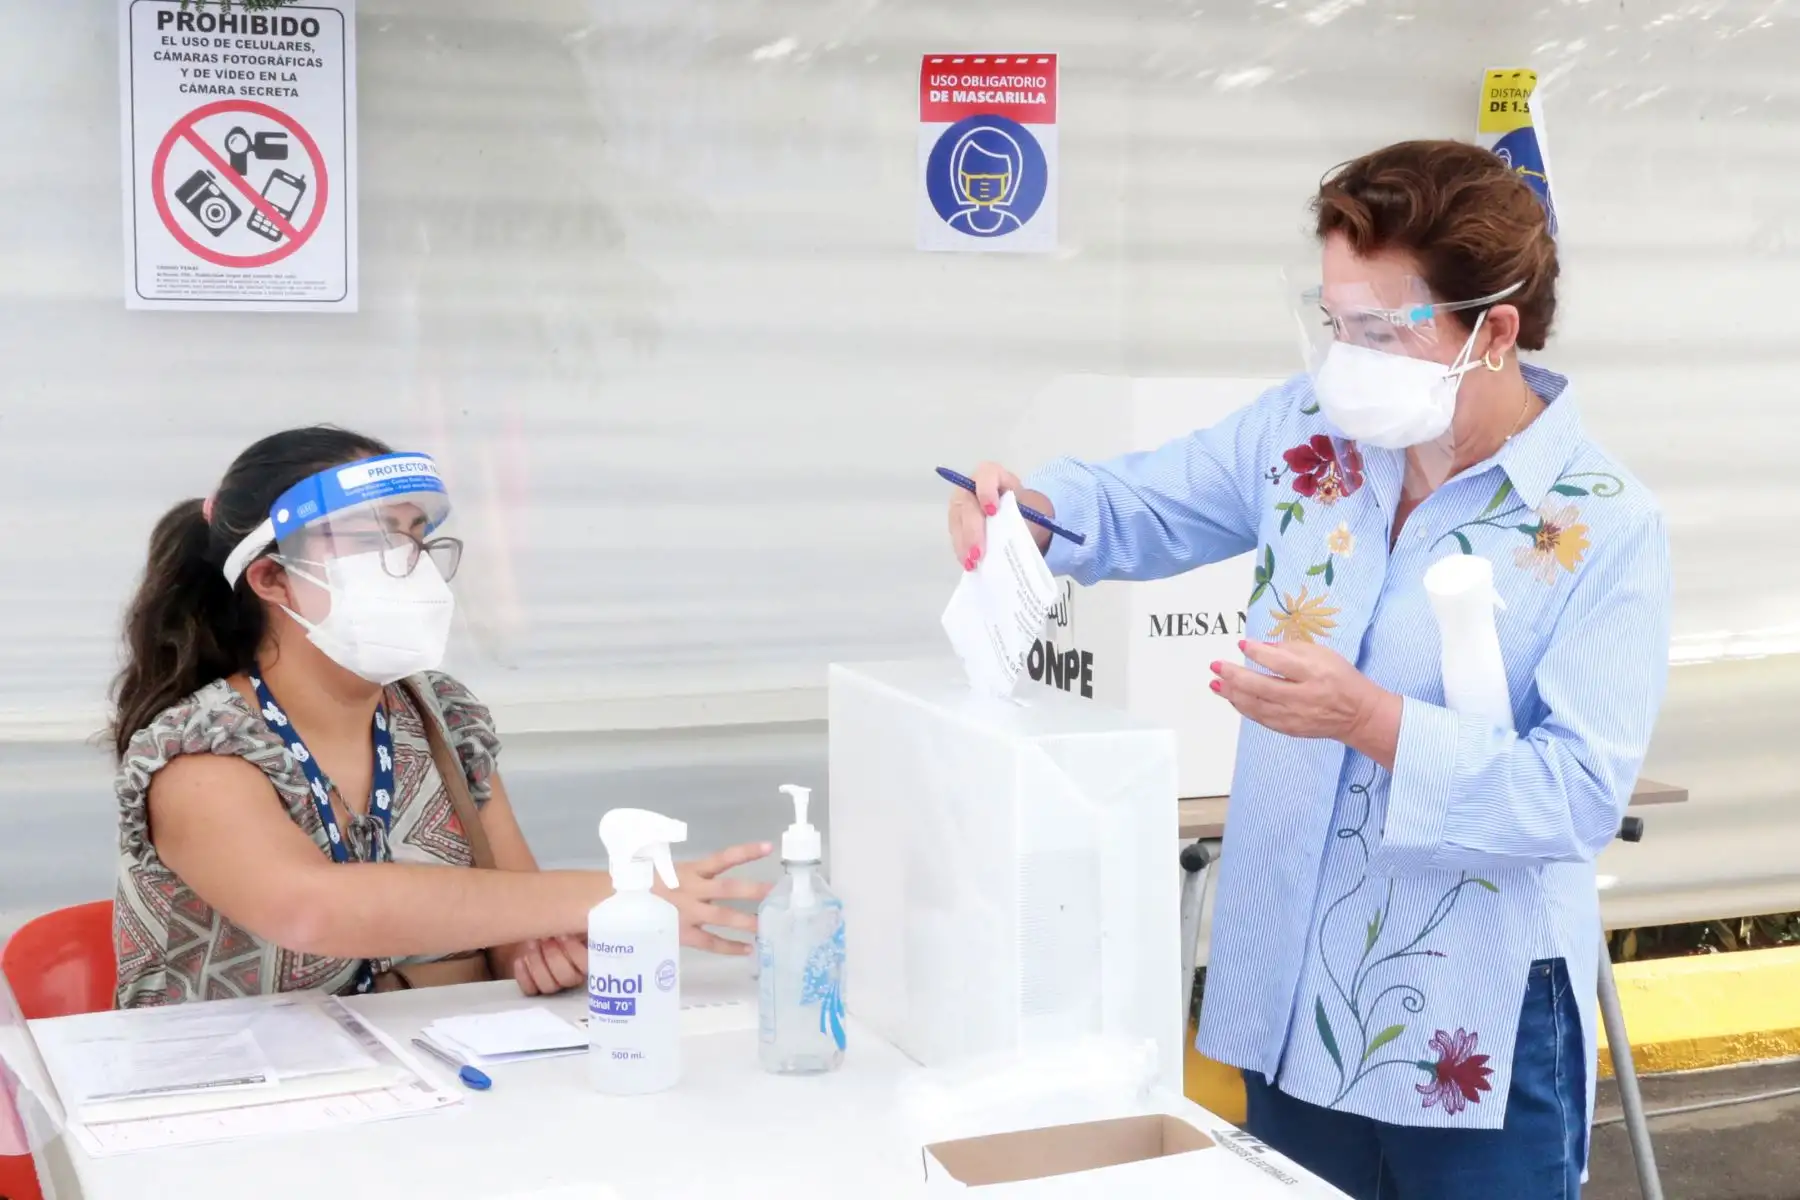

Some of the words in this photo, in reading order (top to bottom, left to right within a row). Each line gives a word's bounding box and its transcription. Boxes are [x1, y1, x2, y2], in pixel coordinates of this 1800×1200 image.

[157, 10, 320, 38] PROHIBIDO
[161, 36, 177, 46] EL
[182, 37, 209, 48] USO
[214, 38, 231, 49] DE
[235, 39, 316, 54] CELULARES,
[153, 50, 218, 64] CÁMARAS
[223, 52, 323, 68] FOTOGRÁFICAS
[180, 68, 190, 78] Y
[194, 69, 211, 79] DE
[215, 68, 255, 81] VÍDEO
[260, 72, 277, 82] EN
[281, 72, 298, 82] LA
[930, 75, 958, 87] USO
[961, 75, 1047, 88] OBLIGATORIO
[179, 83, 235, 96] CÁMARA
[240, 86, 299, 98] SECRETA
[930, 90, 949, 103] DE
[952, 91, 1047, 104] MASCARILLA
[1490, 101, 1508, 112] DE
[368, 462, 430, 478] PROTECTOR
[1149, 611, 1229, 638] MESA
[1027, 638, 1093, 699] ONPE
[611, 1051, 629, 1060] 500
